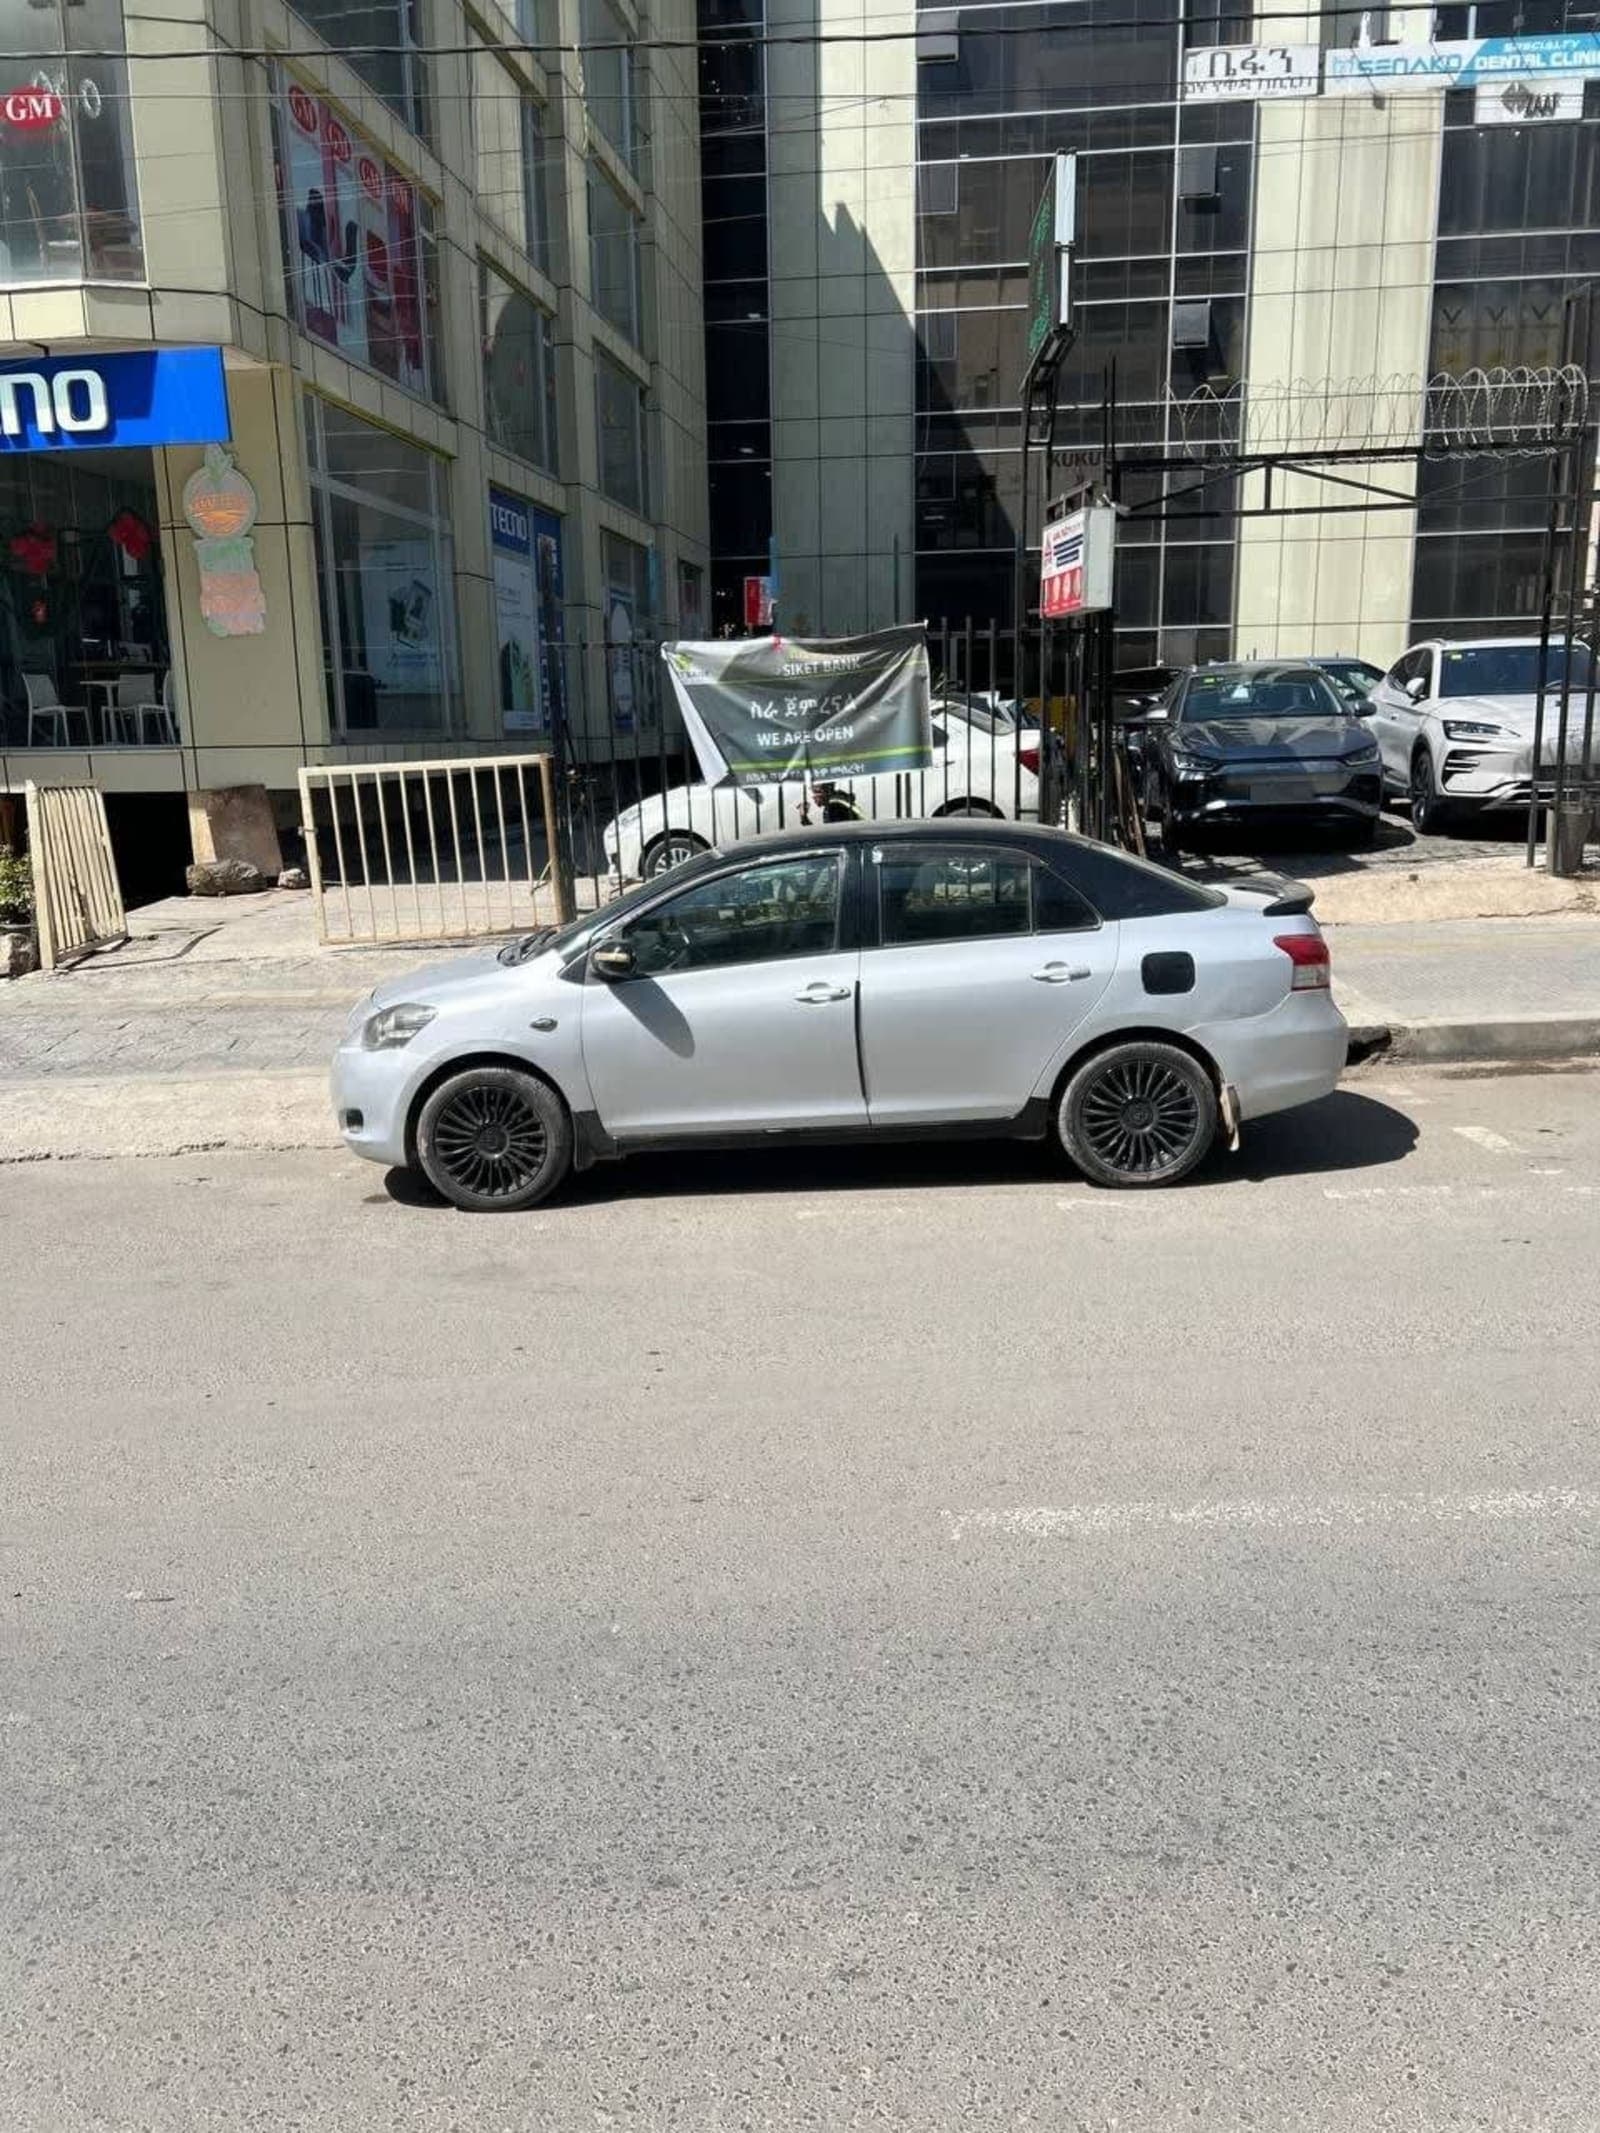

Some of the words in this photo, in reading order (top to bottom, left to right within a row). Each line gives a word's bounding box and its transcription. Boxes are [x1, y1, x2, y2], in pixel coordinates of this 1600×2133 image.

[1474, 52, 1547, 70] DENTAL
[1550, 49, 1600, 68] CLINI
[5, 94, 53, 121] GM
[490, 502, 528, 541] TECNO
[823, 655, 862, 673] BANK
[757, 732, 781, 747] WE
[783, 729, 812, 745] ARE
[814, 726, 855, 743] OPEN
